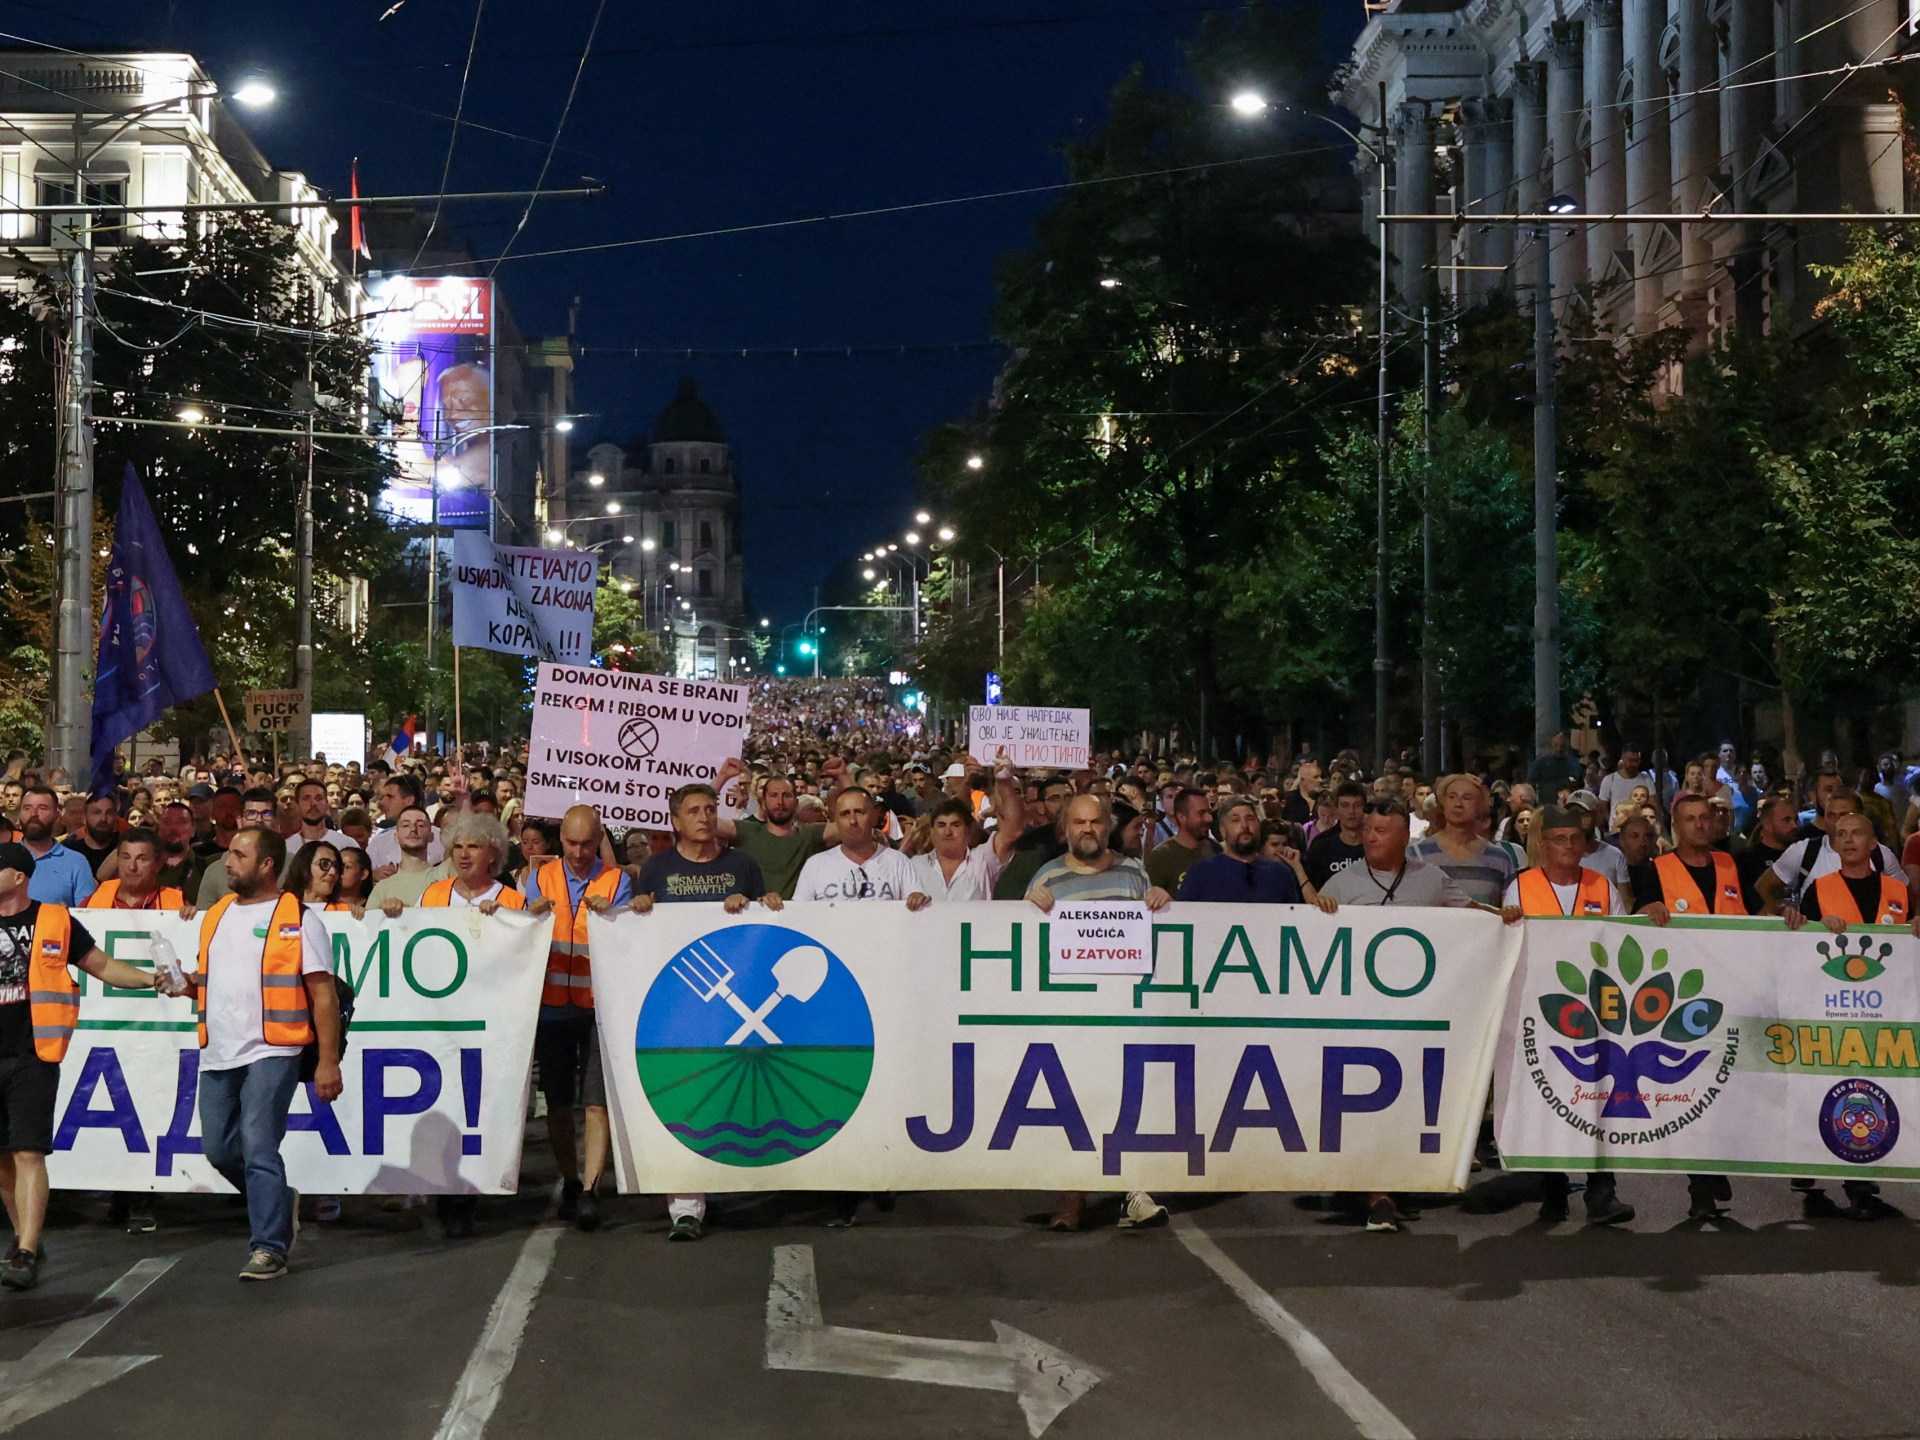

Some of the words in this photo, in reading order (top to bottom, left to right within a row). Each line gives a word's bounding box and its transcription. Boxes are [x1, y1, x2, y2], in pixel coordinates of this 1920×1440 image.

[402, 286, 485, 321] IESEL
[494, 553, 592, 584] HTEVAMO
[531, 585, 594, 613] ZAKONA
[552, 668, 653, 693] DOMOVINA
[658, 680, 678, 696] SE
[683, 683, 738, 703] BRANI
[253, 702, 299, 715] FUCK
[541, 691, 604, 713] REKOM
[618, 701, 677, 721] RIBOM
[682, 709, 694, 723] U
[699, 710, 743, 729] VODI
[971, 707, 991, 722] ОВО
[997, 708, 1020, 722] НИЈЕ
[1027, 709, 1073, 724] НАПРЕДАК
[260, 716, 292, 729] OFF
[978, 726, 996, 740] ОВО
[1002, 726, 1013, 740] ЈЕ
[1020, 726, 1080, 743] УНИШТЕЊЕ!
[546, 748, 551, 762] I
[555, 749, 640, 772] VISOKOM
[1025, 744, 1048, 761] РИО
[1051, 744, 1086, 764] ТИНТО
[530, 771, 620, 795] SMREKOM
[625, 778, 660, 799] ŠTO
[1330, 857, 1364, 872] adi
[674, 884, 727, 896] GROWTH
[680, 874, 721, 886] SMART
[824, 882, 895, 900] CUBA
[1059, 910, 1143, 920] ALEKSANDRA
[1077, 927, 1125, 938] VUČIĆA
[80, 930, 159, 998] Е
[1061, 948, 1071, 960] U
[1076, 948, 1142, 960] ZATVOR!
[1132, 923, 1438, 1010] ДАМО
[1825, 989, 1884, 1009] нЕКО
[1558, 986, 1709, 1038] СЕОС
[1825, 1010, 1848, 1018] брине
[1764, 1023, 1920, 1069] ЗНАМ
[1523, 1016, 1539, 1067] САВЕЗ
[1608, 1086, 1721, 1145] ОРГАНИЗАЦИЈА
[1715, 1027, 1740, 1085] СРБИЈЕ
[1655, 1087, 1696, 1107] дамо!
[905, 1042, 1446, 1177] ЈАДАР!
